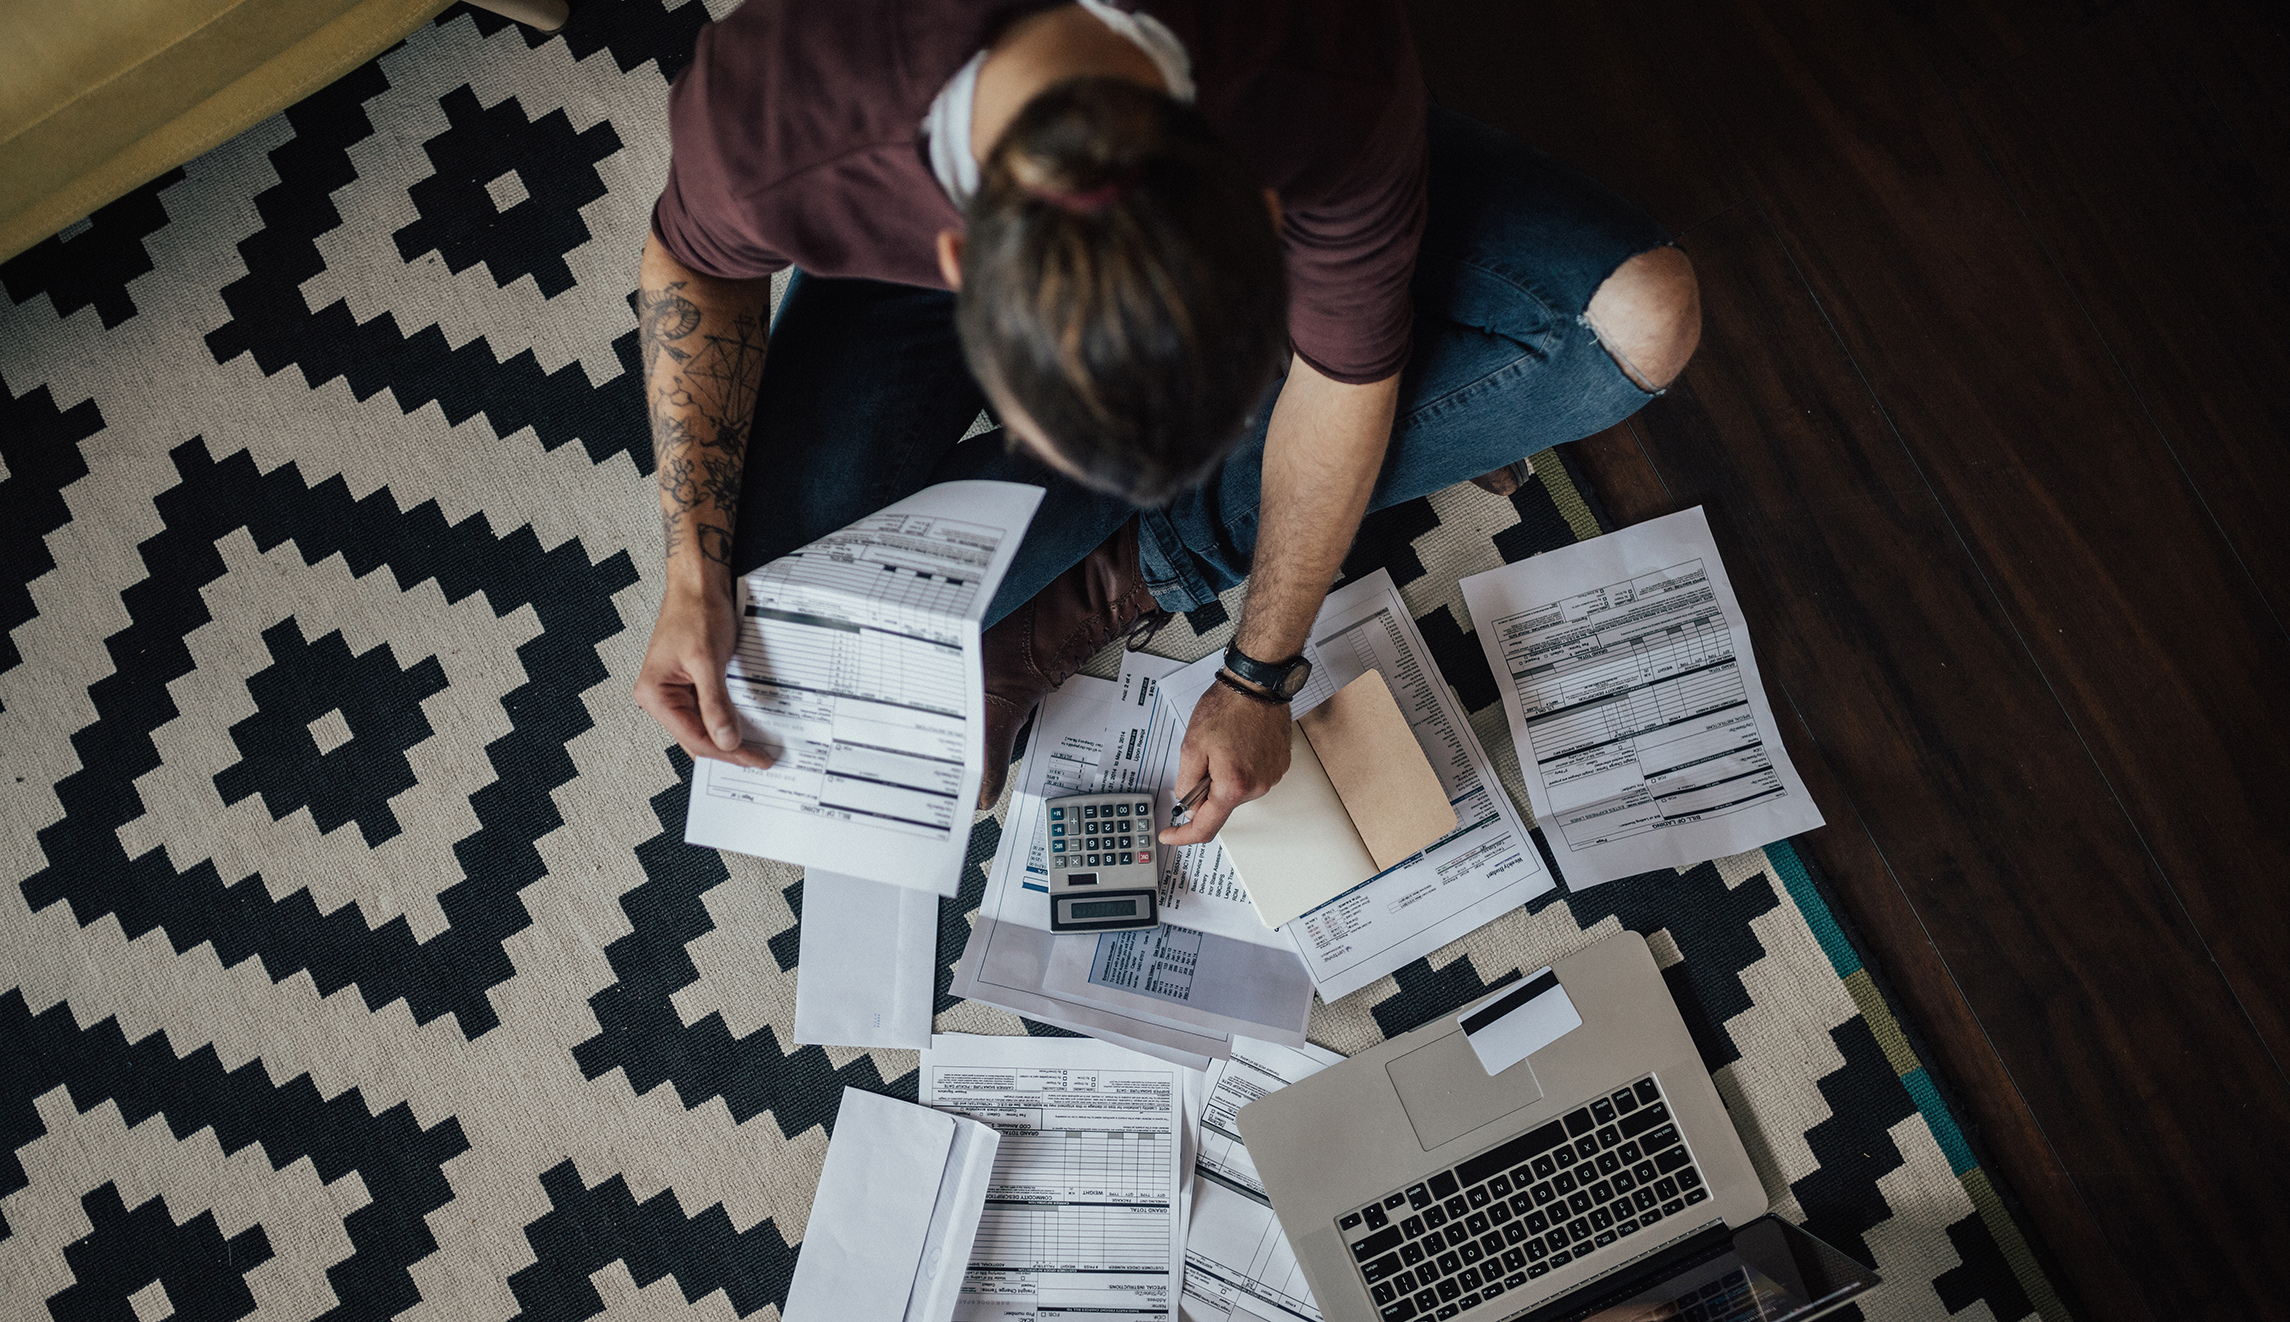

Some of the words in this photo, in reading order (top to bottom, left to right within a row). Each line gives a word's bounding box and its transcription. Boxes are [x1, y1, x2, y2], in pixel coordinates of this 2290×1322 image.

[1137, 729, 1145, 747] Receipt
[1585, 810, 1608, 819] EXPRESS
[1608, 805, 1625, 813] ESTES
[1570, 816, 1585, 824] LINES
[1652, 820, 1676, 829] LADING
[1194, 859, 1202, 877] Service
[1504, 857, 1523, 869] Weekly
[1486, 866, 1505, 878] Budget
[1163, 875, 1171, 885] May
[1178, 871, 1186, 889] Electric
[1199, 874, 1208, 894] Delivery
[1224, 881, 1233, 899] Legacy
[1120, 970, 1128, 985] following
[1616, 1091, 1630, 1100] control
[1596, 1101, 1608, 1109] option
